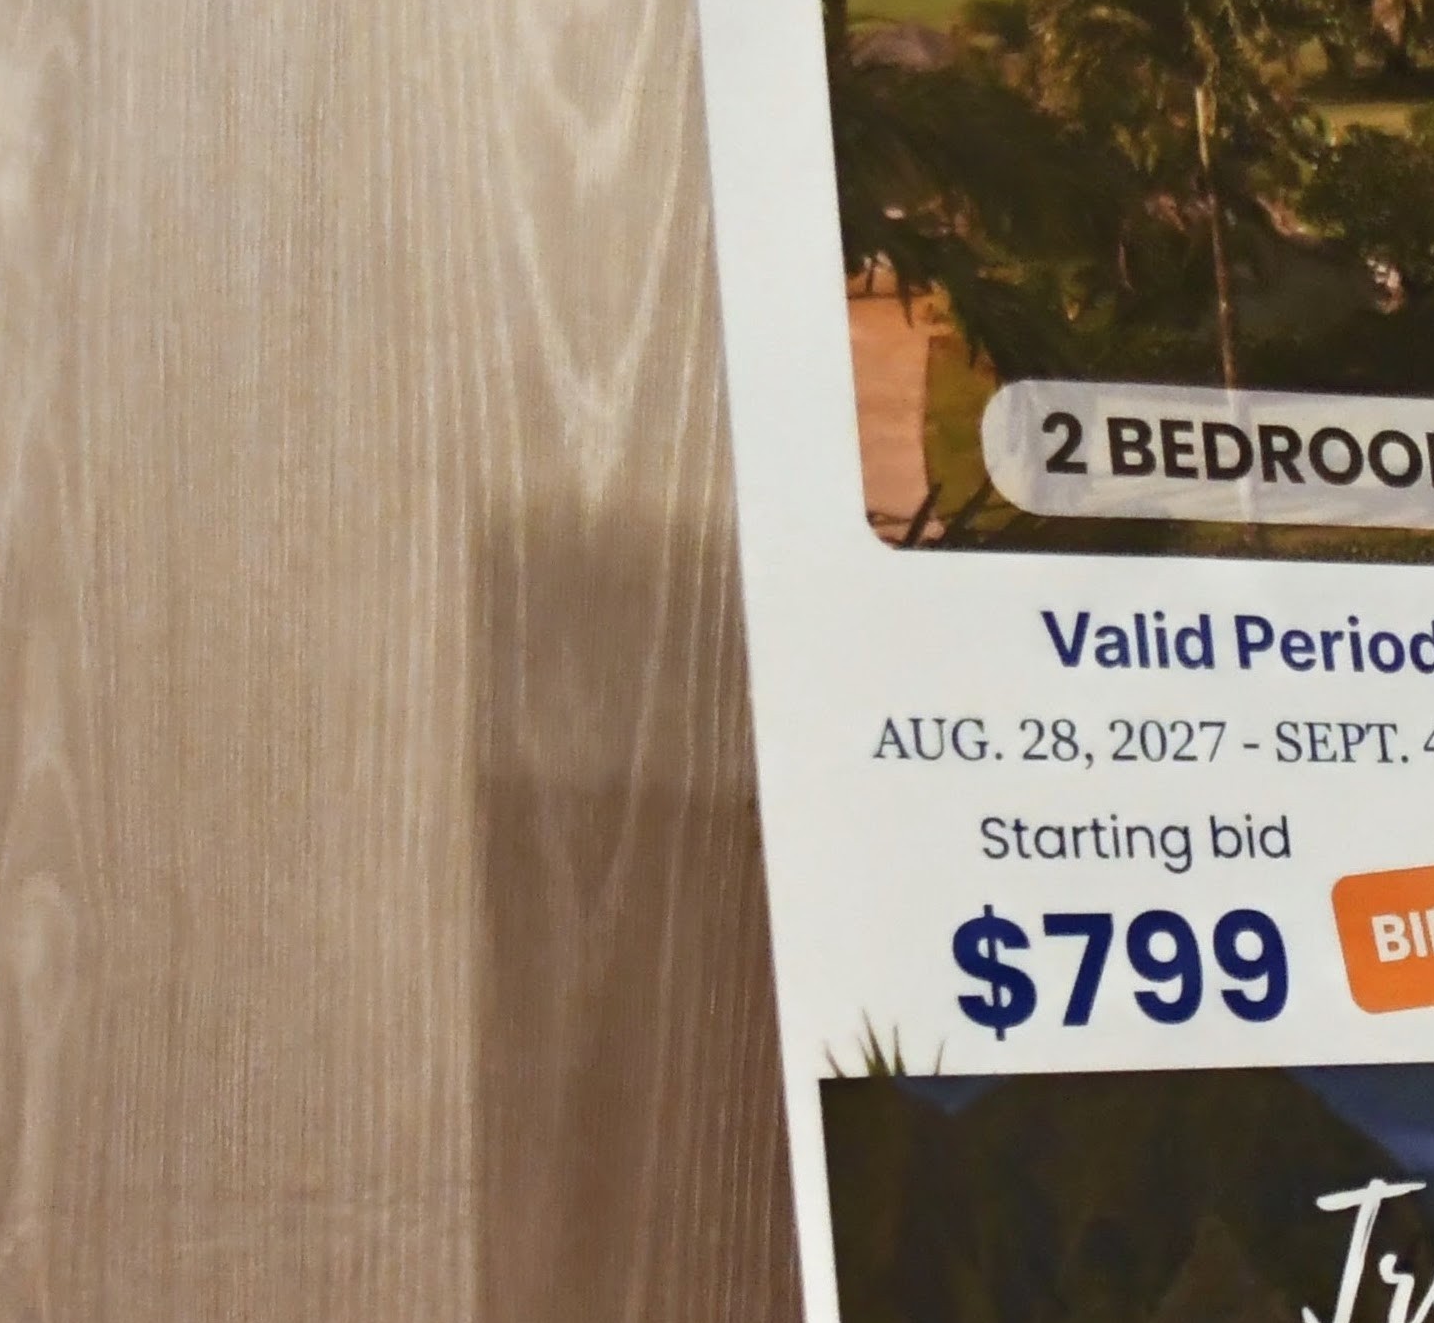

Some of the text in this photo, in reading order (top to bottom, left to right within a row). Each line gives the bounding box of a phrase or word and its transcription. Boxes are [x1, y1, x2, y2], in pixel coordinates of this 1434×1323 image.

[1042, 411, 1089, 475] 2
[1041, 610, 1216, 670] Valid
[872, 715, 1002, 761] AUG.
[1018, 718, 1094, 769] 28,
[1108, 718, 1226, 763] 2027
[1275, 720, 1409, 764] SEPT.
[980, 813, 1292, 873] Starting bid
[949, 905, 1291, 1041] $799
